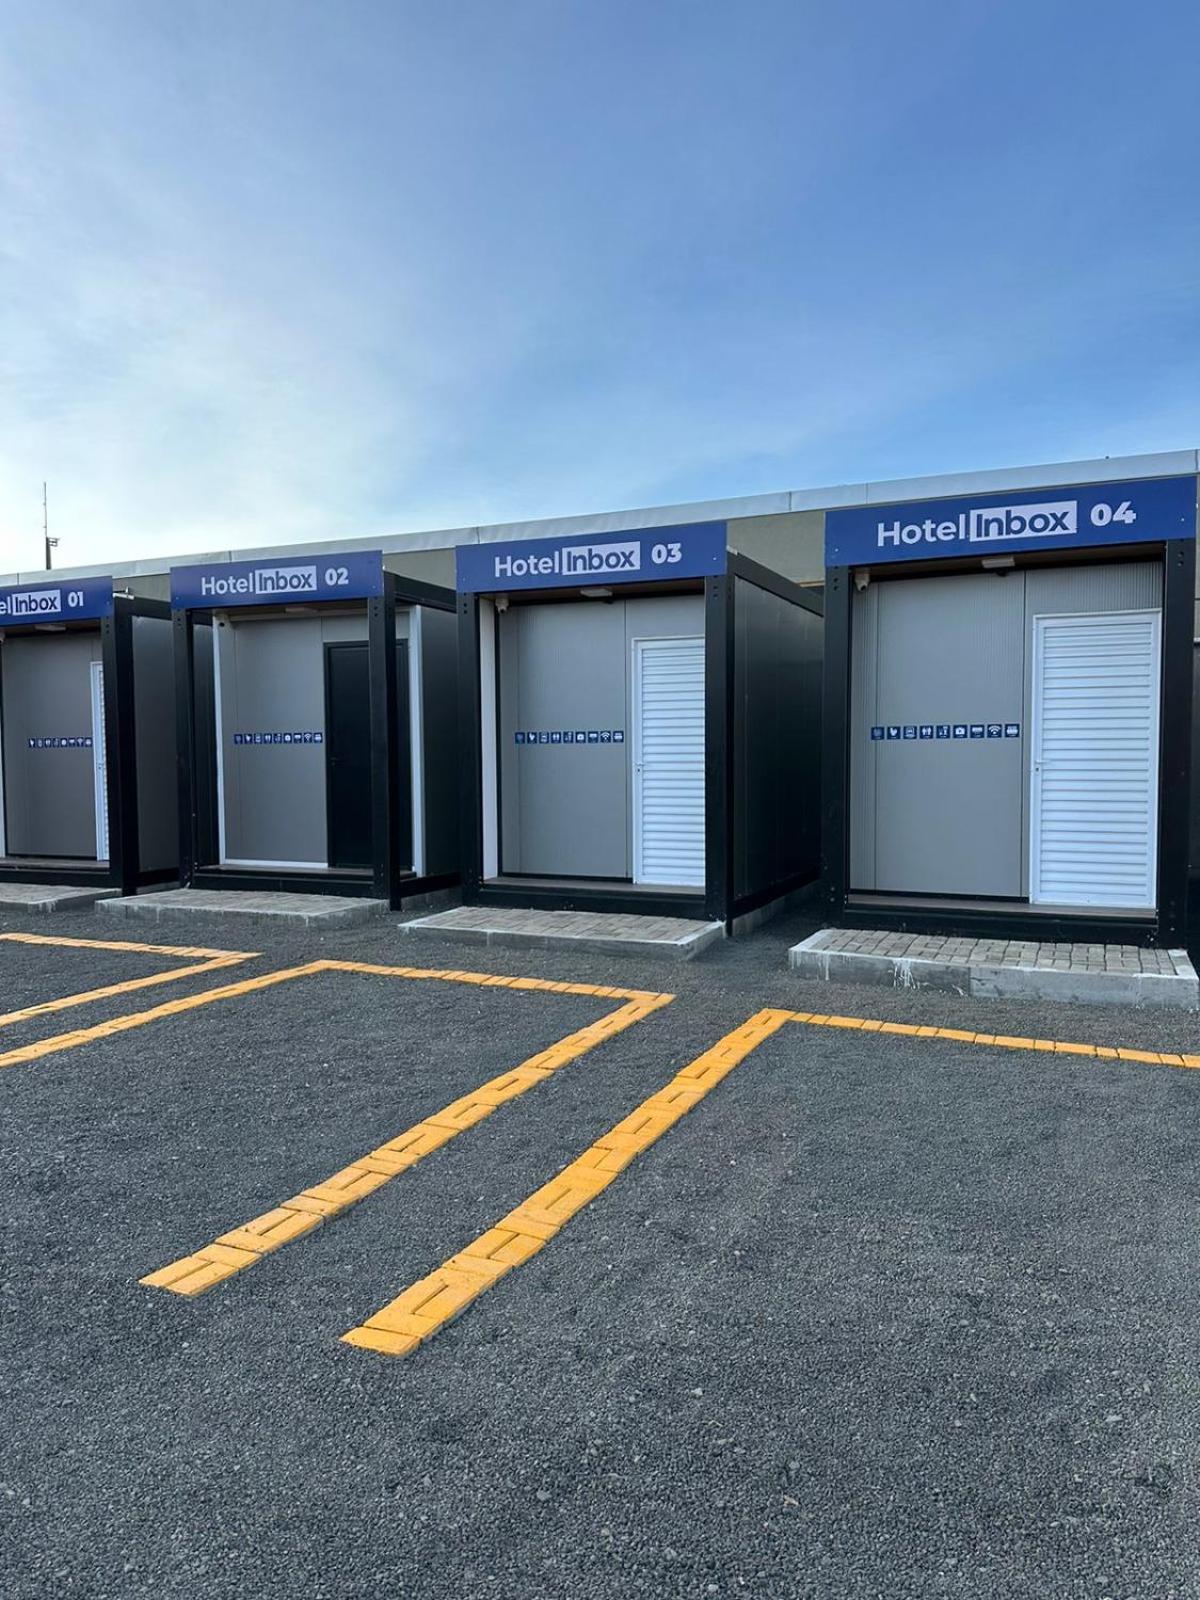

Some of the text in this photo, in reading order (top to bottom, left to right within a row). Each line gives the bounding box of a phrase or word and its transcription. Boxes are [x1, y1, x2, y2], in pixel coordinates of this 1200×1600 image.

[877, 501, 1137, 547] Hotel Inbox 04
[494, 543, 682, 577] Hotel Inbox 03
[201, 568, 349, 596] Hotel Inbox 02
[15, 594, 58, 613] Inbox
[68, 591, 84, 608] 01
